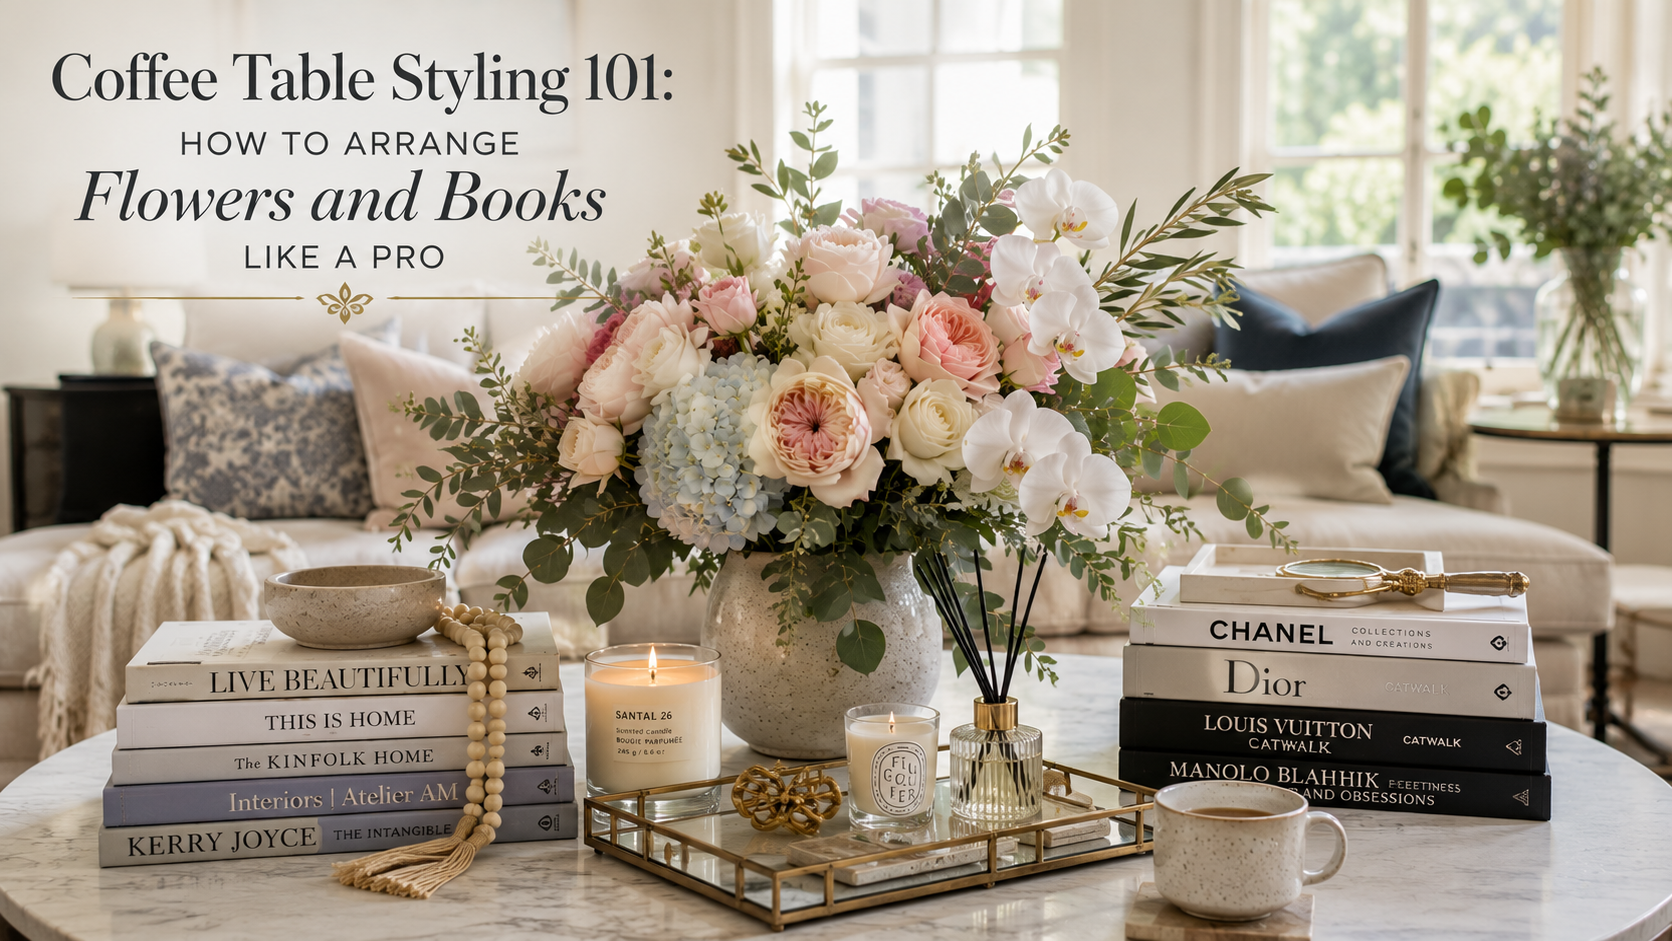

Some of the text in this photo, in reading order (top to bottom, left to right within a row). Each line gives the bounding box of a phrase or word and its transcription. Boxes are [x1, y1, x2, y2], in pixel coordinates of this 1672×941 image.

[1209, 619, 1432, 646] CHANEL COLLECTIONS
[1351, 639, 1434, 650] AND CREATIONS
[209, 664, 470, 694] LIVE BEAUTIFULLY
[1223, 659, 1450, 698] Dior CATWALK
[264, 709, 416, 732] THIS IS HOME
[615, 710, 673, 721] SANTAL 26
[1203, 715, 1374, 740] LOUIS VUITTON
[1248, 737, 1332, 755] CATWALK
[1403, 735, 1462, 748] CATWALK
[234, 748, 435, 770] The KINFOLK HOME
[1169, 761, 1270, 783] MANOLO
[1277, 766, 1380, 789] BLAHHIK
[229, 790, 323, 812] Interiors
[341, 785, 414, 807] Atelier
[420, 782, 459, 802] AM
[1303, 788, 1335, 801] AND
[1340, 789, 1436, 806] OBSESSIONS
[128, 823, 453, 857] KERRY JOYCE THE INTANGIBLE
